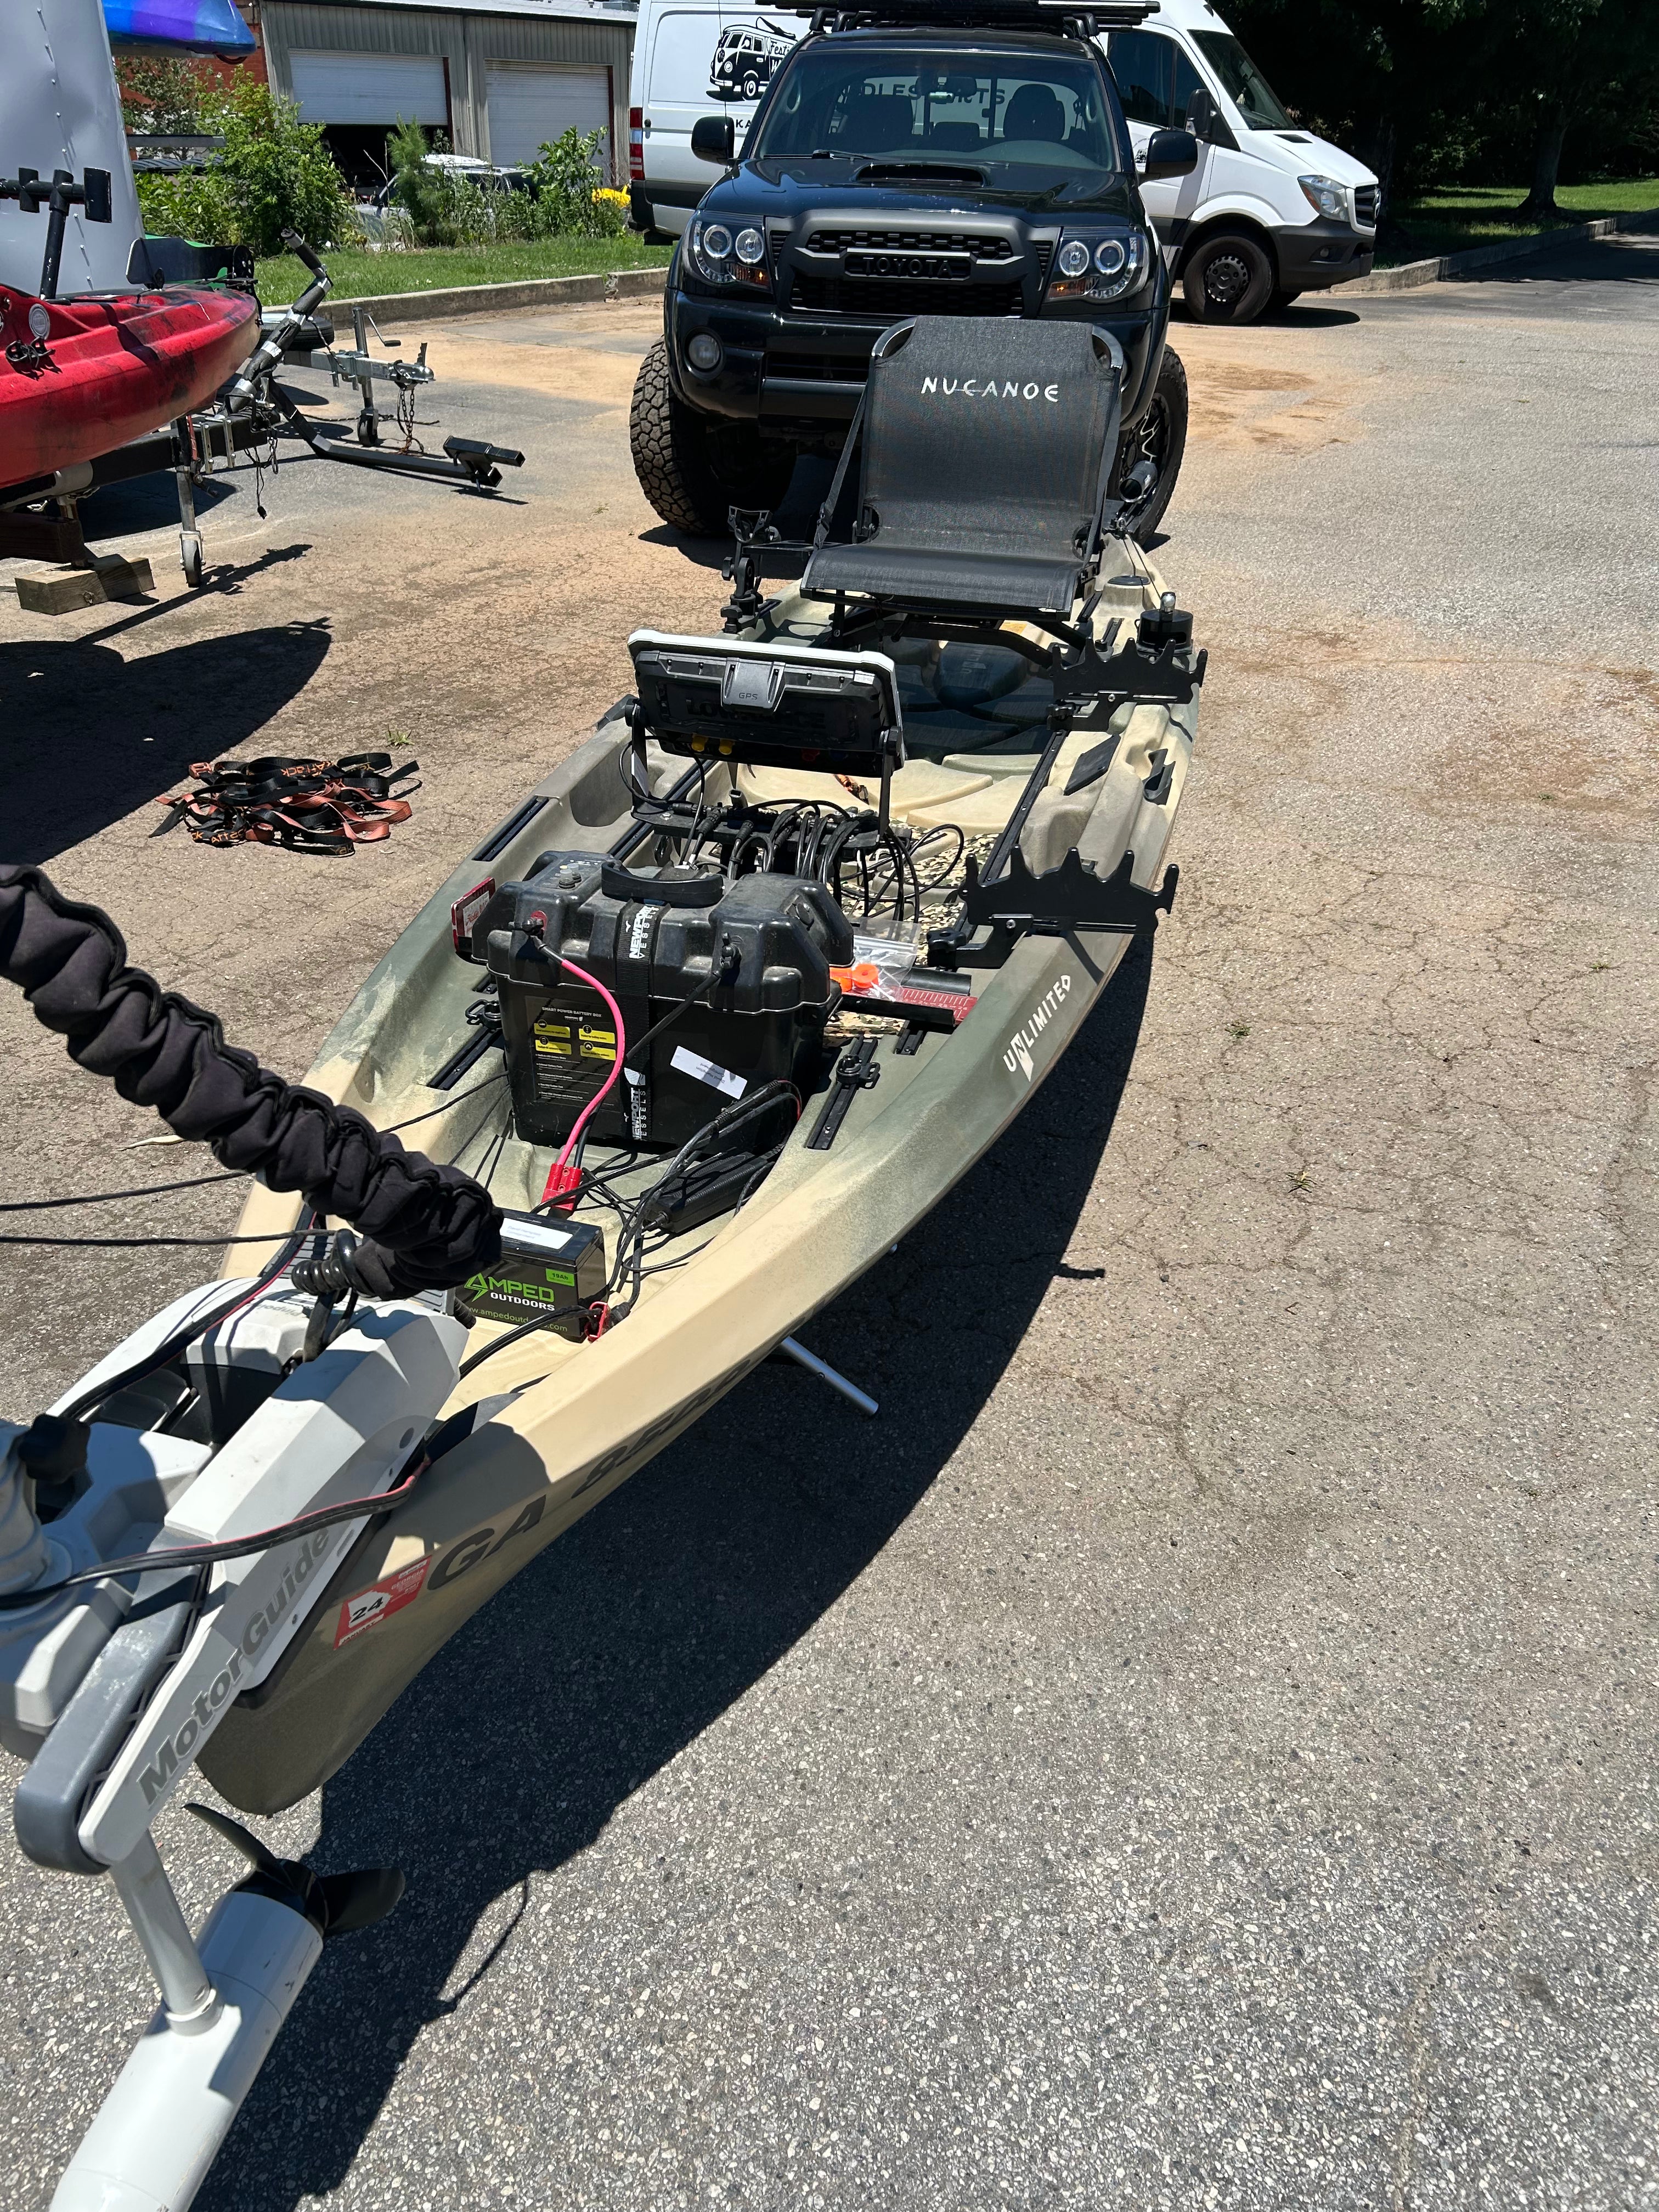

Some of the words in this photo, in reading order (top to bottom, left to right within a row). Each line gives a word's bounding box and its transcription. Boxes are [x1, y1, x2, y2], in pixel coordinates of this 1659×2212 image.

[862, 257, 953, 279] TOYOTA
[921, 377, 1058, 402] NUCANOE
[738, 692, 758, 701] GPS
[1003, 975, 1071, 1082] UNLIMITED
[464, 1273, 555, 1302] AMPED
[490, 1292, 555, 1312] OUTDOORS
[427, 1494, 547, 1591] GA
[350, 1596, 383, 1623] 24
[136, 1528, 329, 1806] MotorGuide
